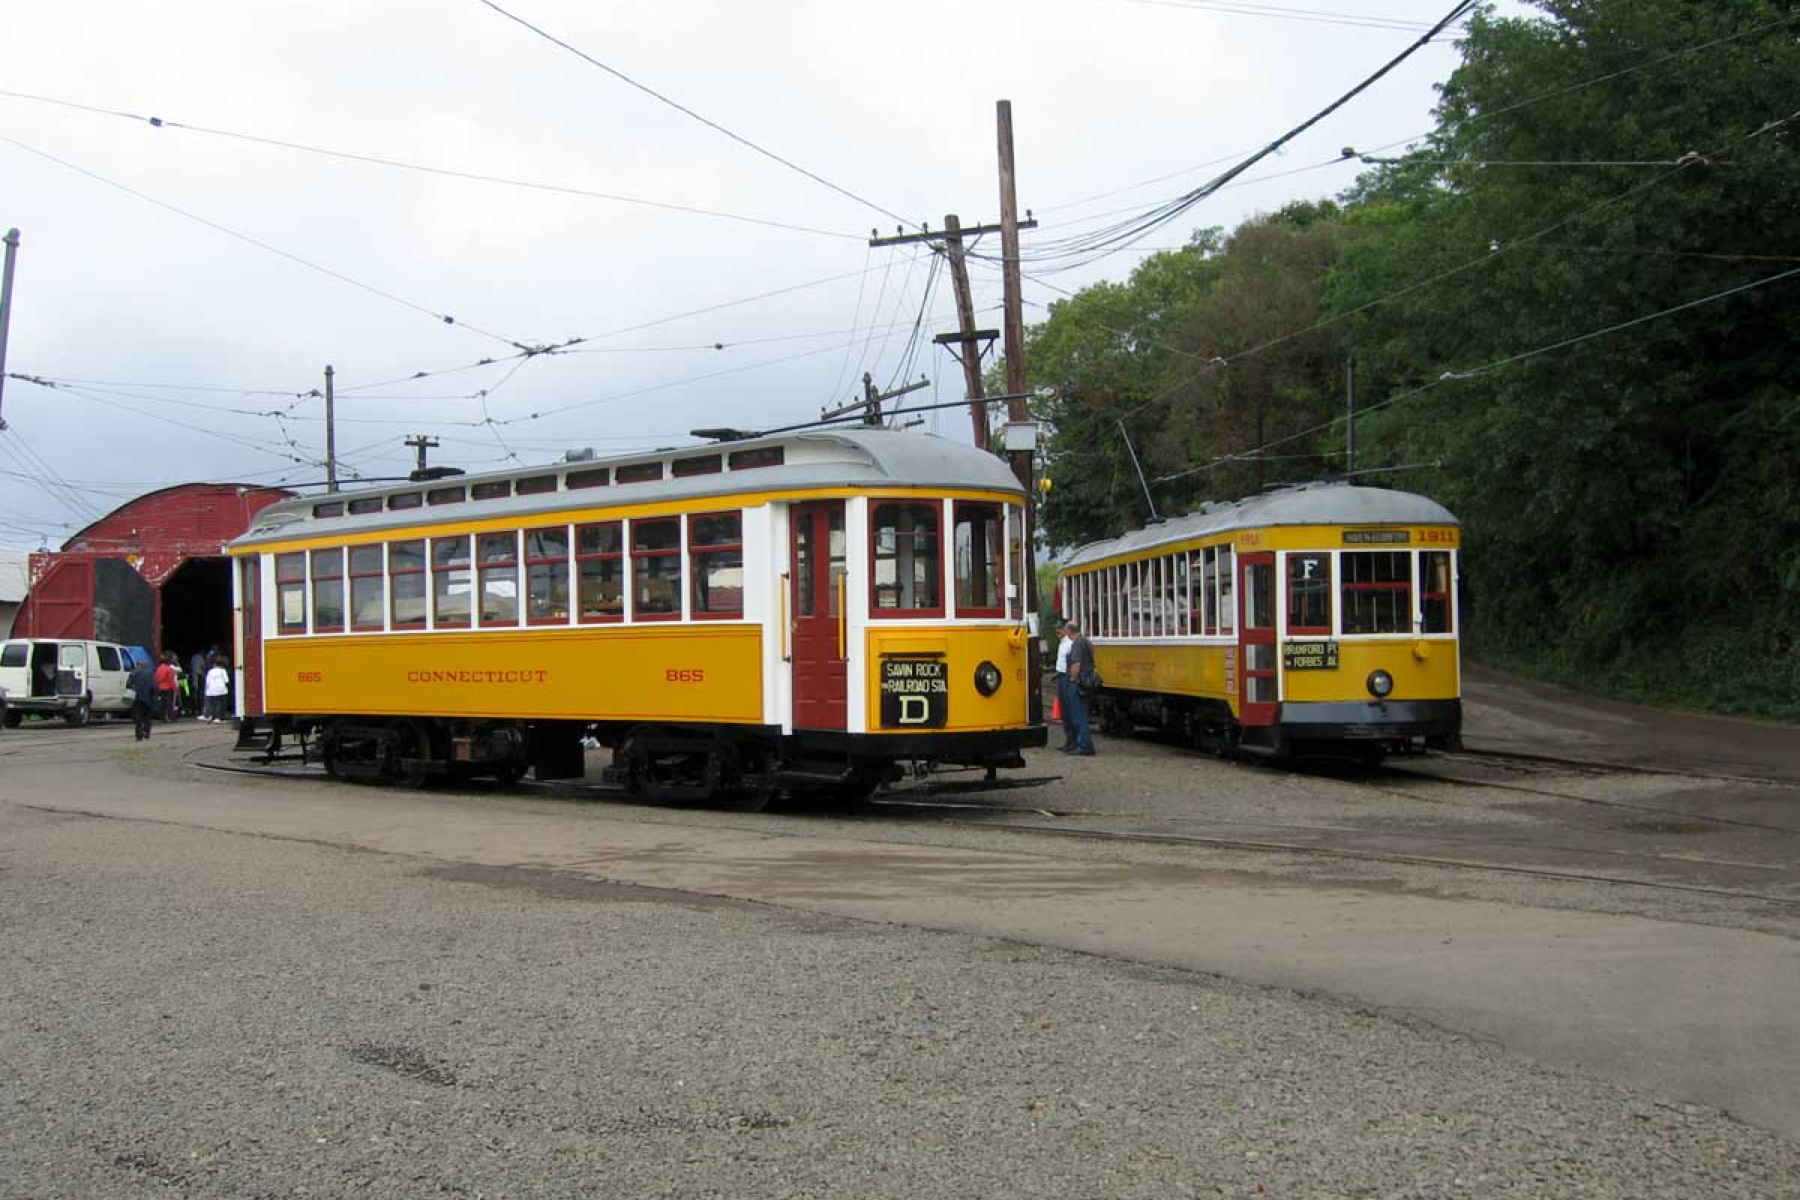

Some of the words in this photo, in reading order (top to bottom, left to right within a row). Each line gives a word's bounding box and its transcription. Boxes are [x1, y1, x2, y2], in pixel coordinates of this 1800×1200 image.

[1419, 529, 1454, 542] 1911
[1303, 559, 1318, 579] F
[297, 671, 321, 682] 865
[407, 670, 548, 684] CONNECTICUT
[665, 669, 704, 682] 865
[886, 663, 913, 677] SAVIN
[916, 663, 943, 677] ROCK
[888, 679, 930, 694] RAILROAD
[898, 695, 930, 724] D
